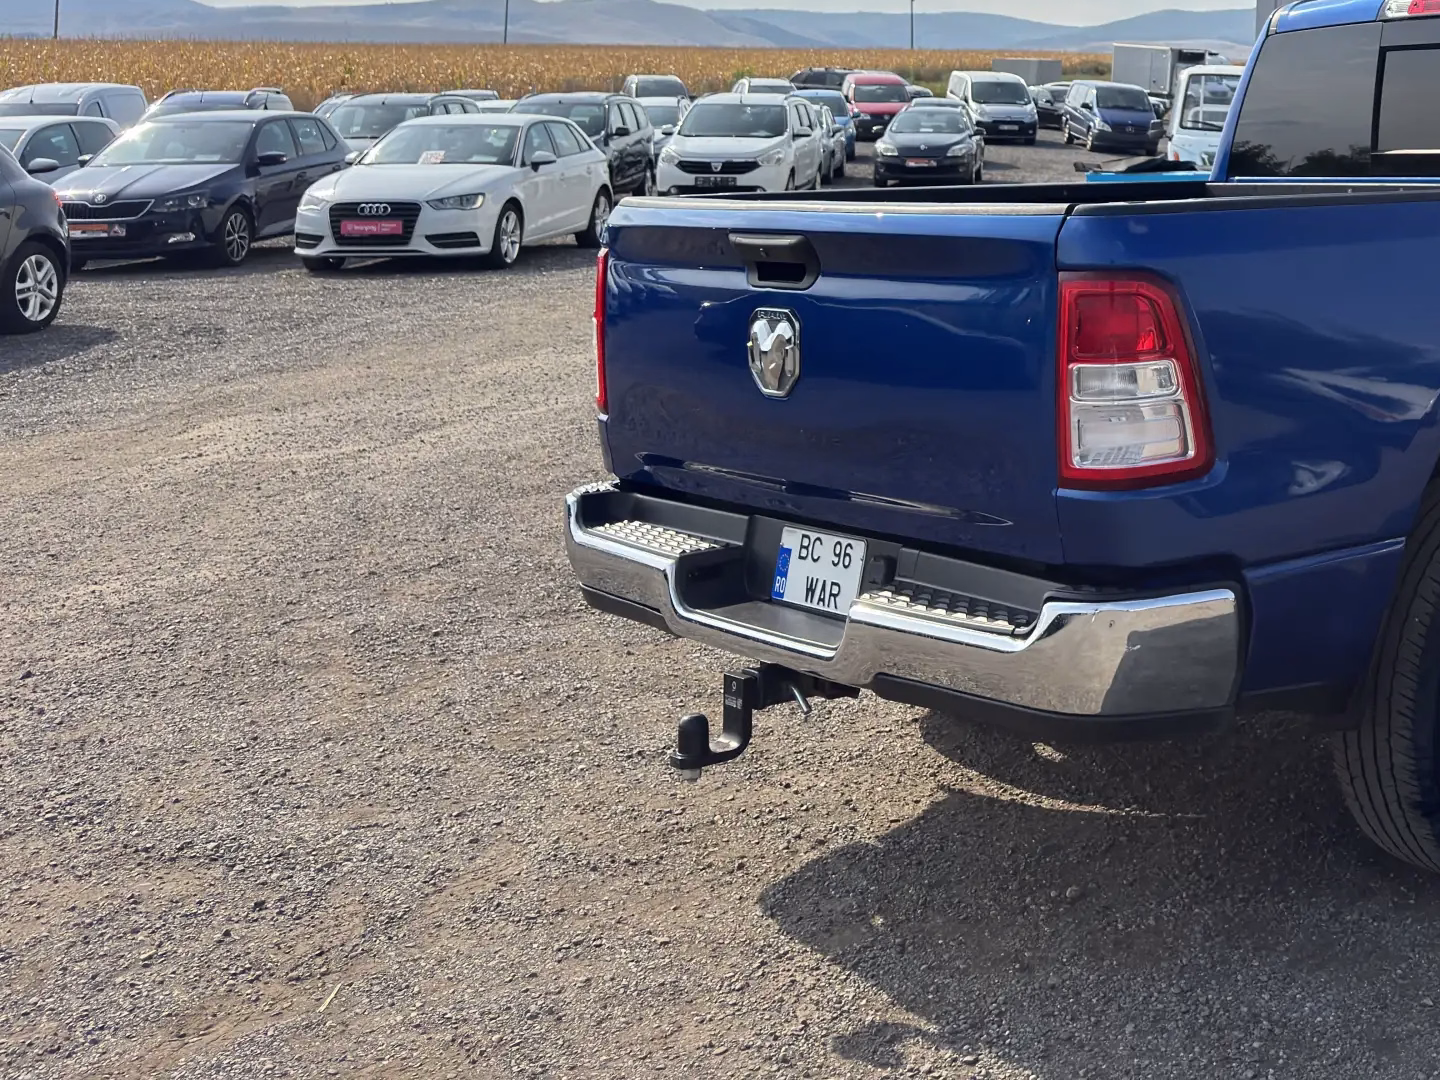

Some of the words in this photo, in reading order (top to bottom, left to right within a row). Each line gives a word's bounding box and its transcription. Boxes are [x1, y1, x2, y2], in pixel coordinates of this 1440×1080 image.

[798, 533, 823, 563] BC
[831, 540, 853, 570] 96
[774, 576, 786, 593] RO
[804, 575, 841, 610] WAR
